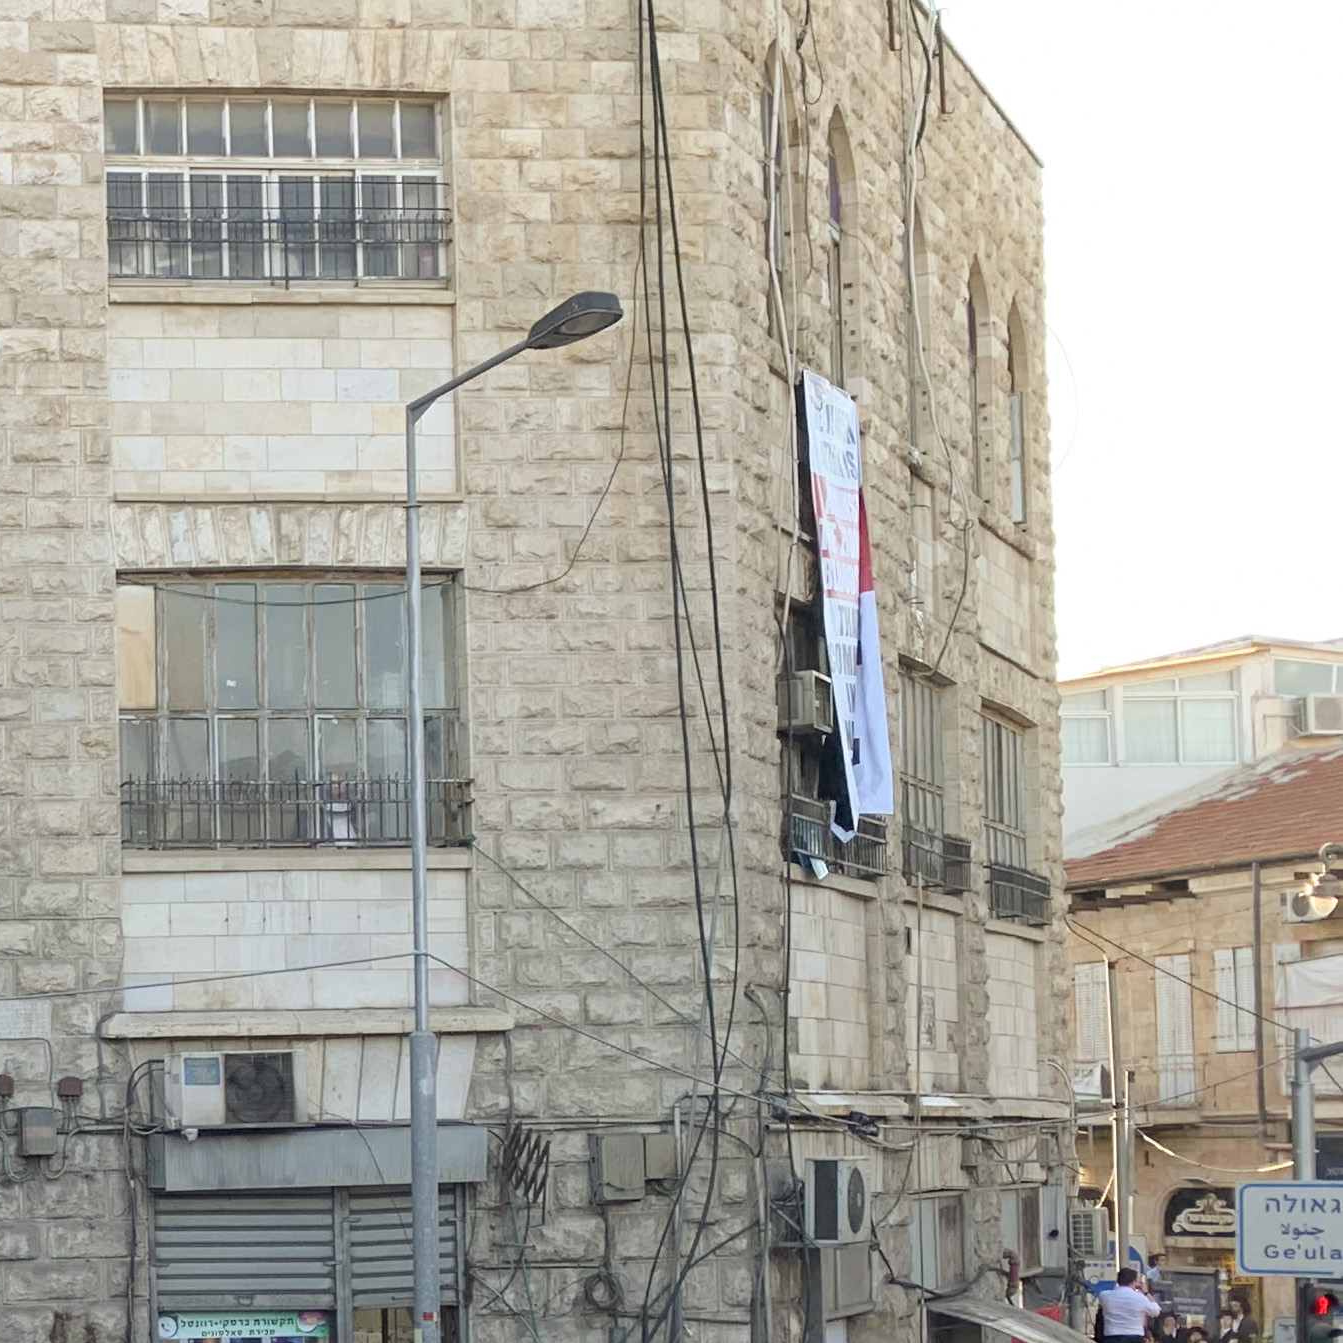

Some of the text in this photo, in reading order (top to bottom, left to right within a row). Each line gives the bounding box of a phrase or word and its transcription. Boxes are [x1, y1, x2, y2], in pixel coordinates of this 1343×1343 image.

[1265, 1194, 1342, 1214] גאולה
[1264, 1243, 1343, 1260] Ge'ula
[253, 1318, 294, 1327] תקשורת
